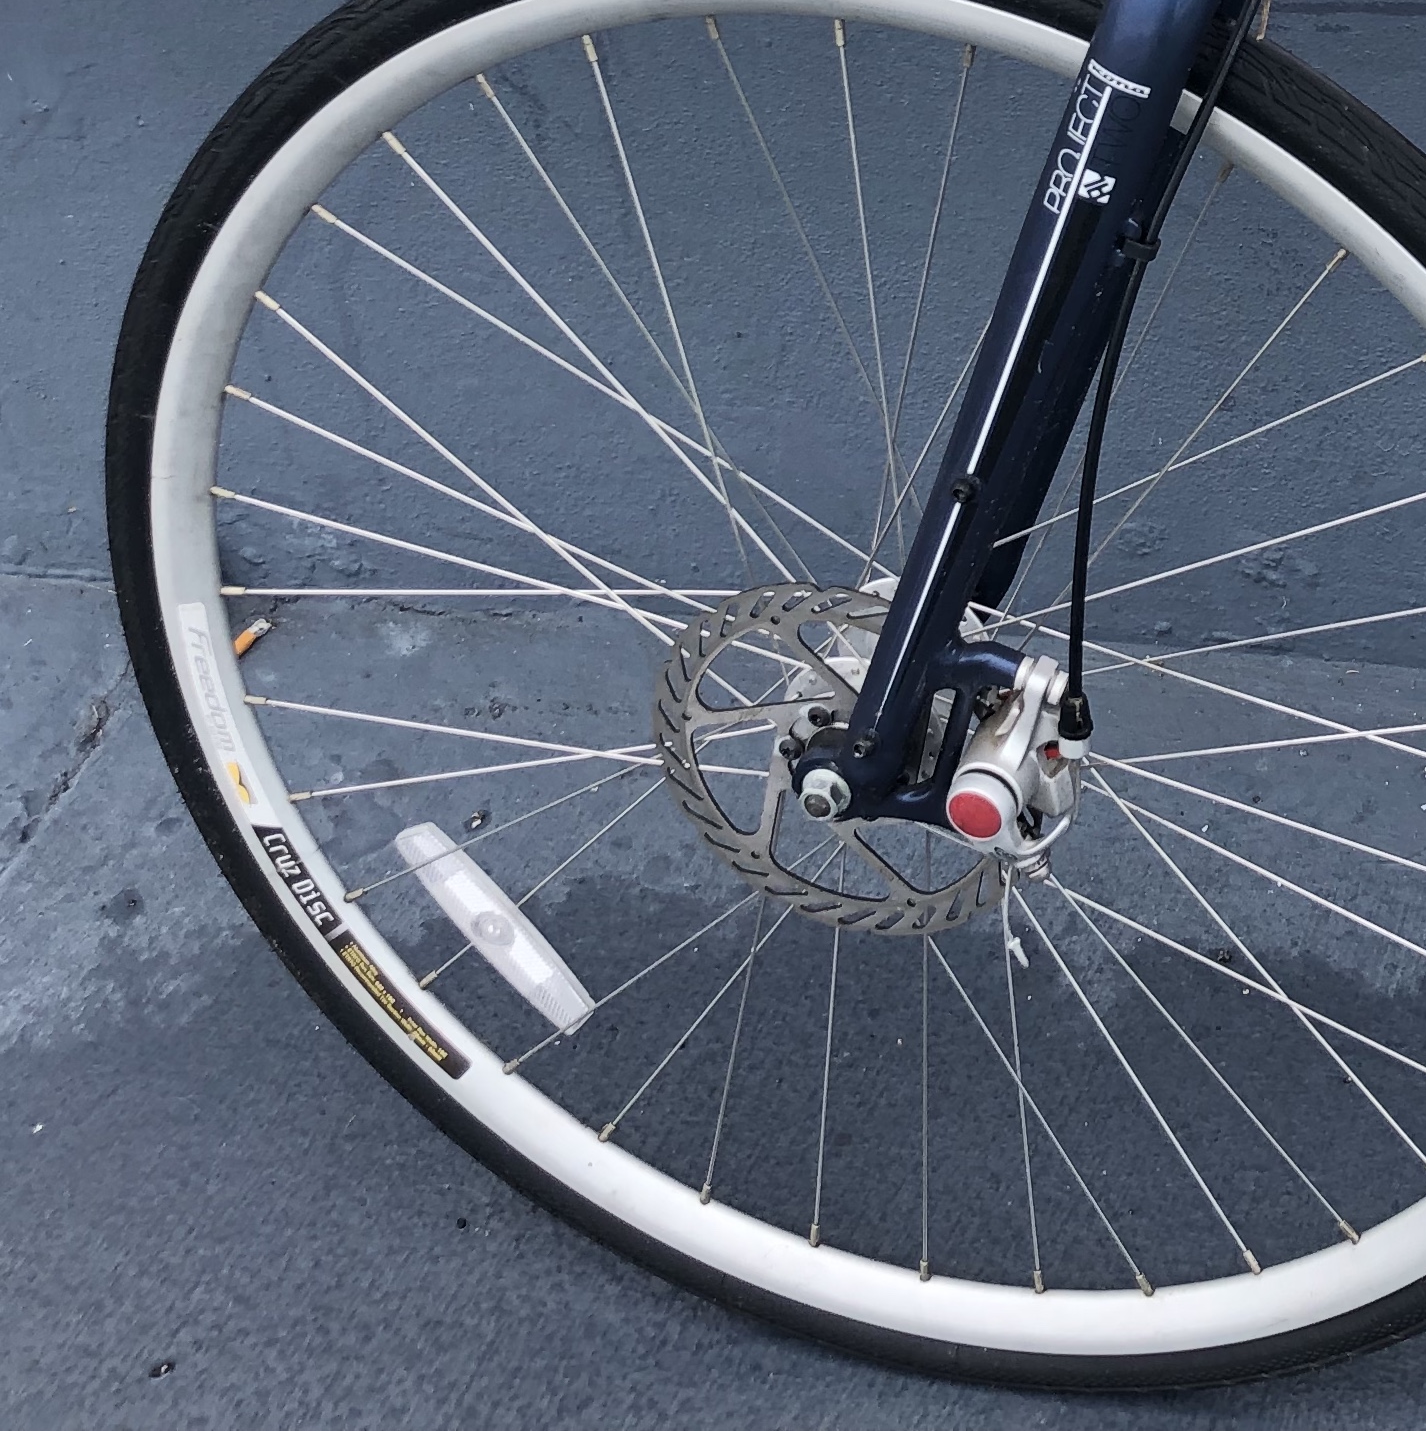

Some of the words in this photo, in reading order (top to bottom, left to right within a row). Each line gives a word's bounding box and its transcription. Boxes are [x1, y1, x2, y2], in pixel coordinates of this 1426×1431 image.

[187, 627, 237, 753] Freedom
[263, 832, 303, 880] Cruz
[291, 877, 337, 929] Disc
